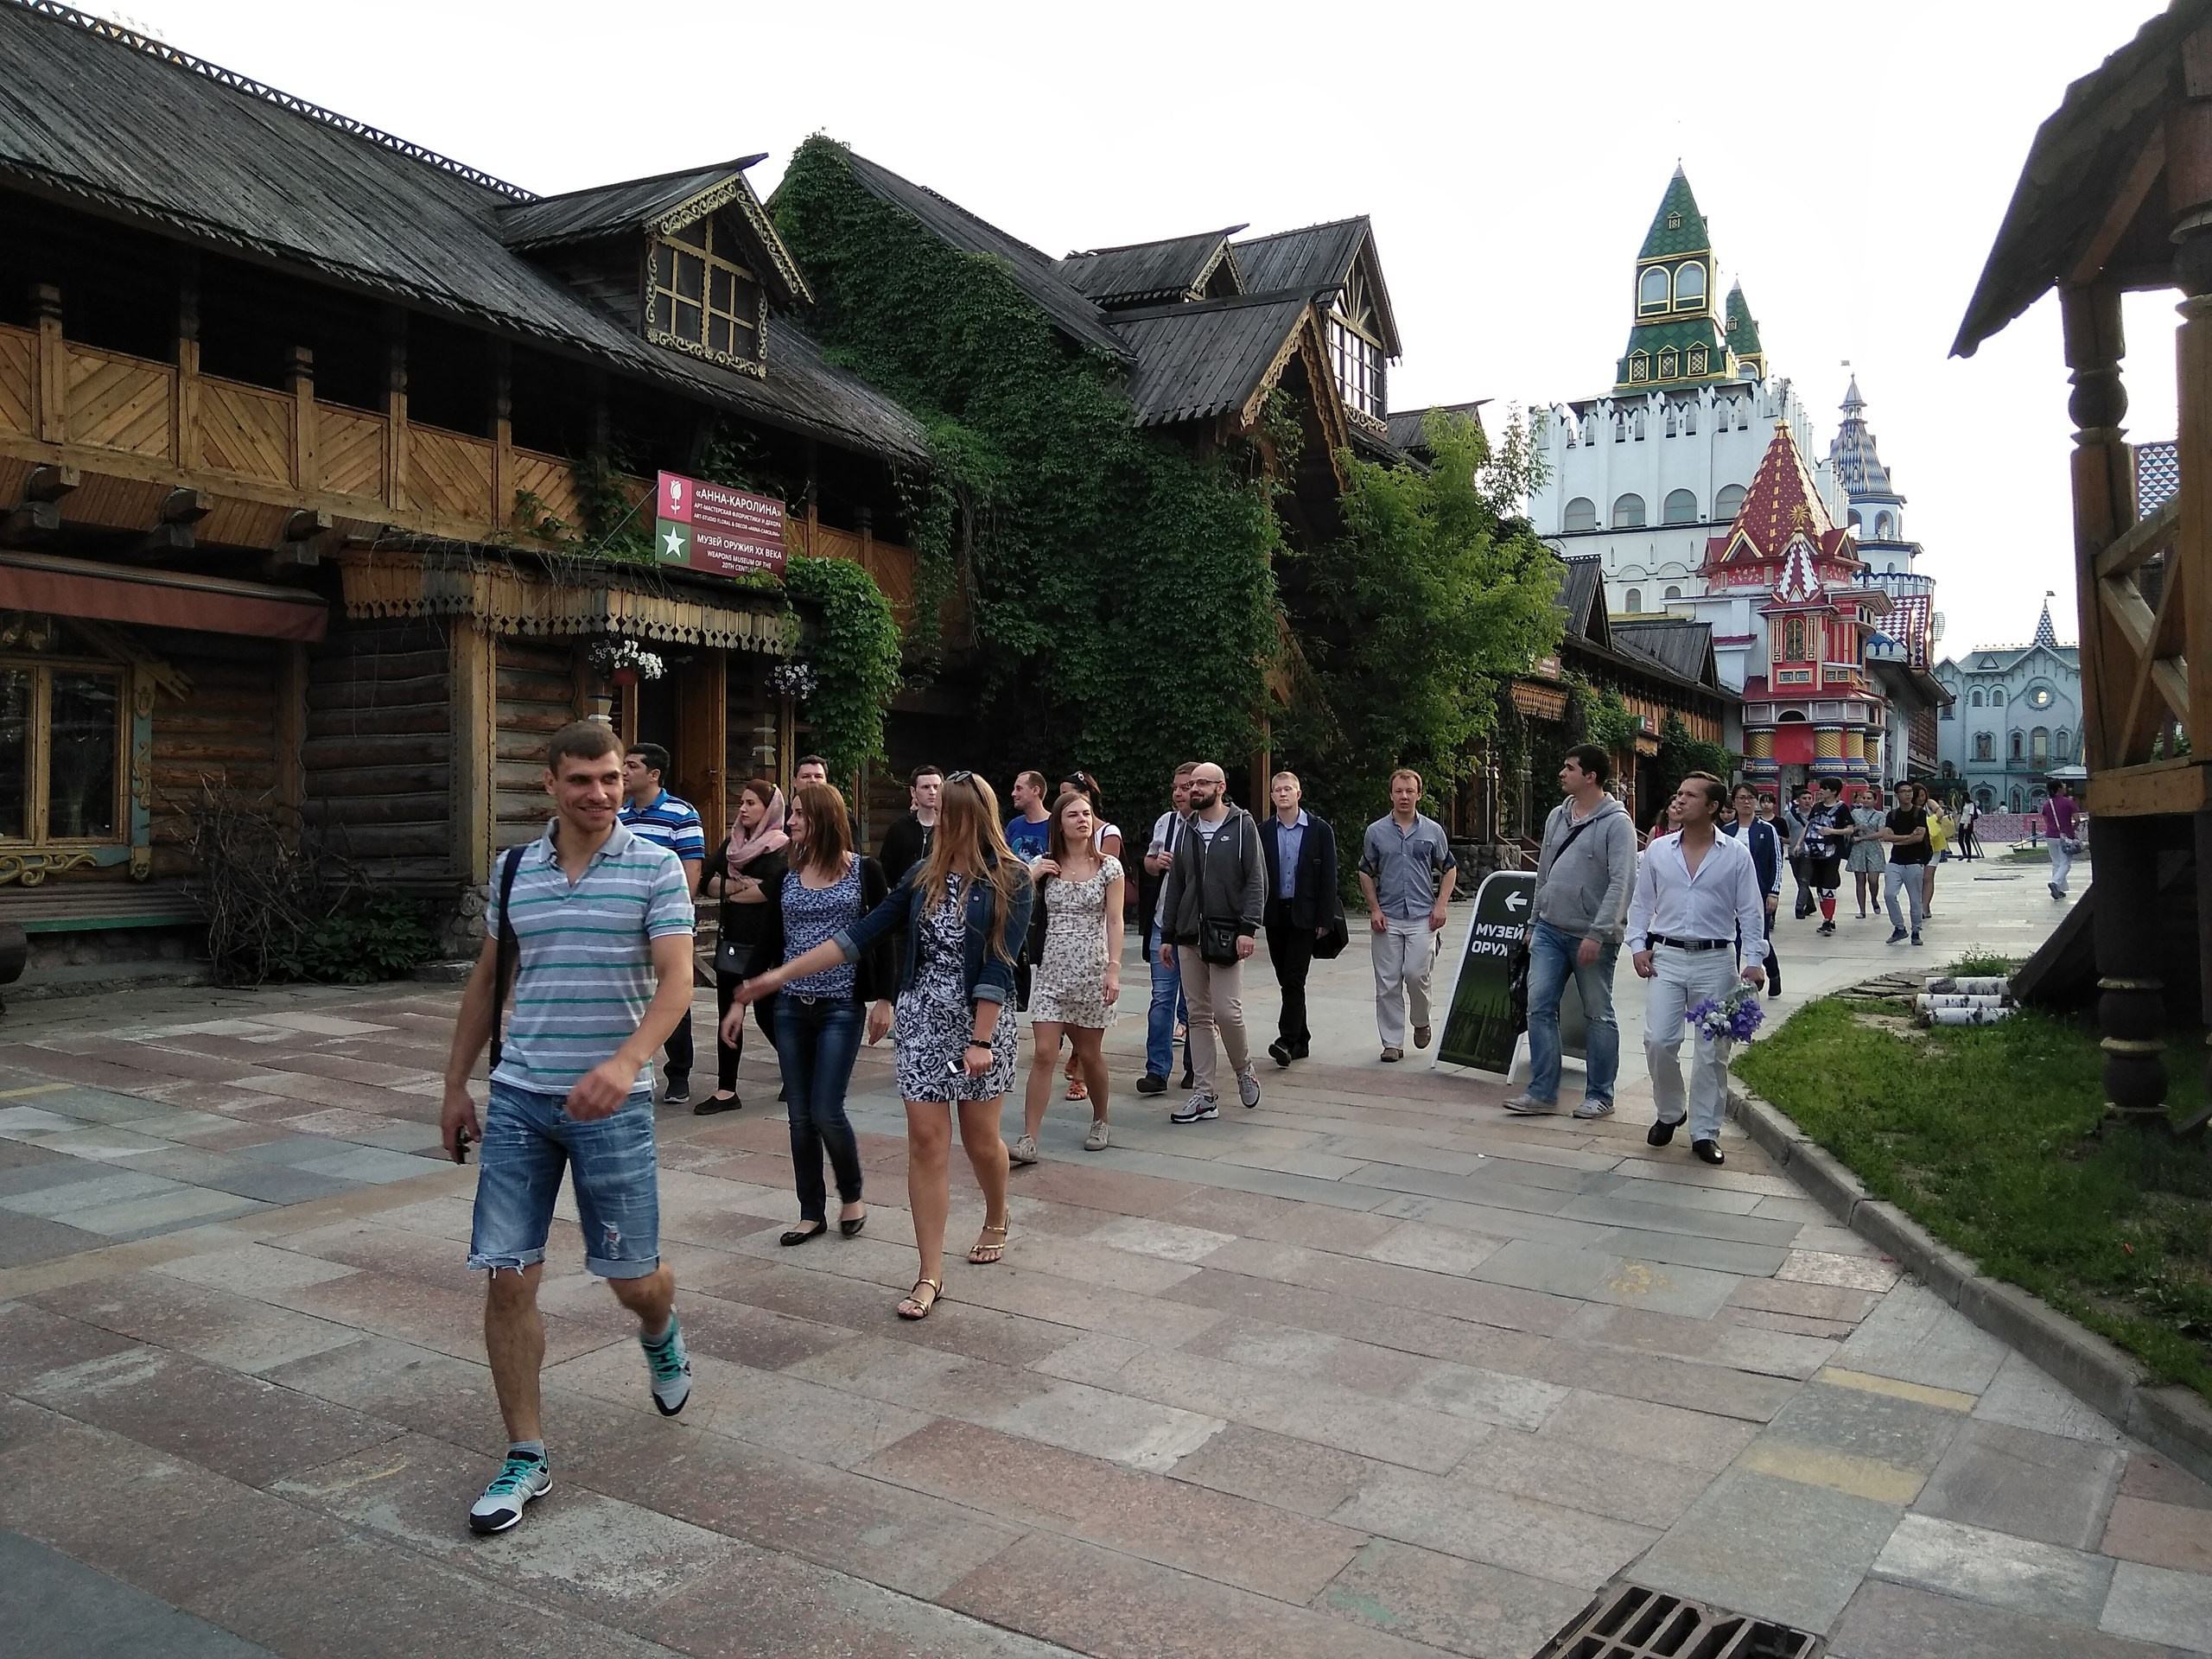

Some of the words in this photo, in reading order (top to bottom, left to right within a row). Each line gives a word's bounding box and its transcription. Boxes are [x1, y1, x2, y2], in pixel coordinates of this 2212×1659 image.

[696, 488, 782, 518] «АННА-КАРОЛИНА»
[694, 502, 732, 516] АРТ-МАСТЕРСКАЯ
[732, 511, 761, 523] ФЛОРИСТИКИ
[765, 519, 782, 528] ДЕКОРА
[694, 513, 717, 523] ART-STUDIO
[717, 518, 731, 526] FLORAL
[696, 533, 722, 548] МУЗЕЙ
[723, 540, 754, 554] ОРУЖИЯ
[766, 549, 782, 560] ВЕКА
[707, 550, 732, 562] WEAPONS
[733, 556, 754, 566] MUSEUM
[721, 562, 734, 570] 20TH
[1476, 923, 1525, 940] МУЗЕЙ
[1471, 940, 1509, 957] ОРУЖ
